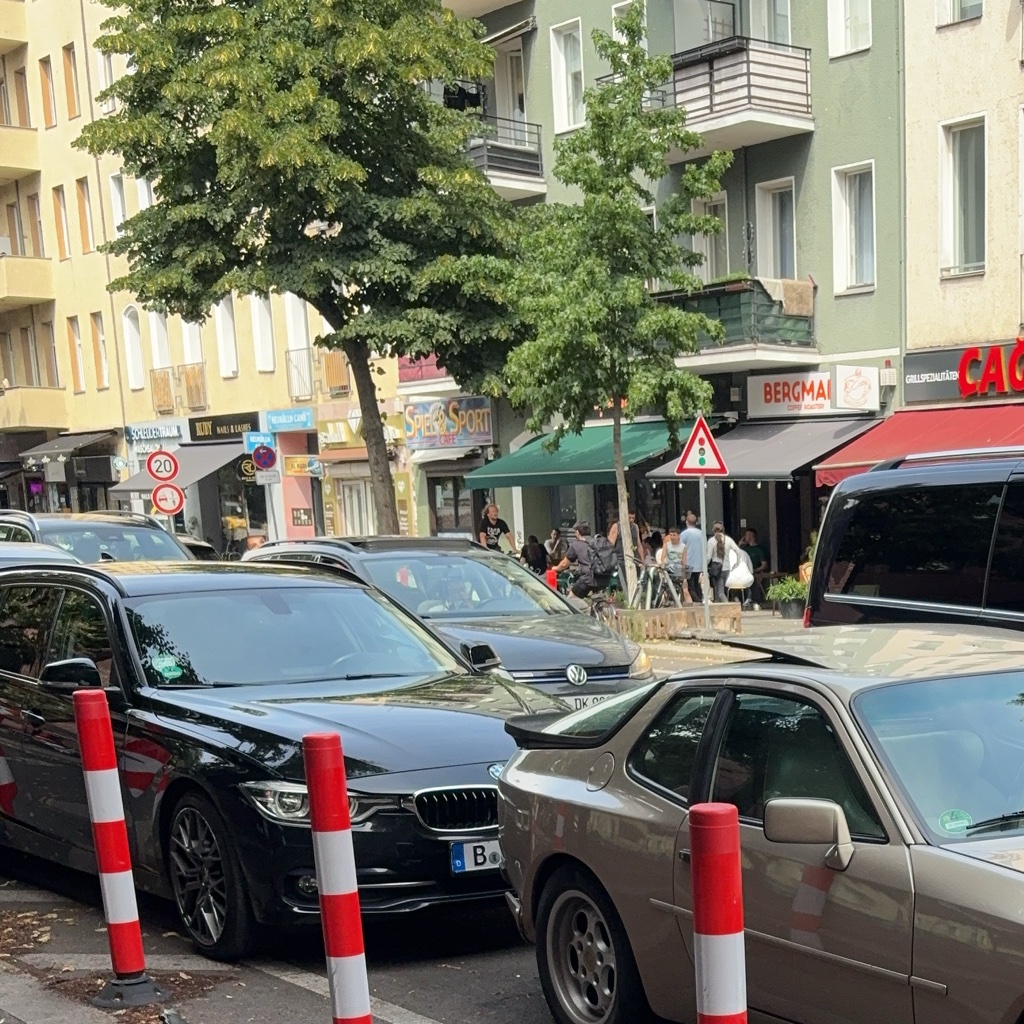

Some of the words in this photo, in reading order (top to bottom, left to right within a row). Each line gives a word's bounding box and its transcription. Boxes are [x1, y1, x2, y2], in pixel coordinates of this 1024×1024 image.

[905, 370, 960, 384] GRILLSPEZIALITÄTEN
[154, 459, 172, 473] 20
[473, 845, 487, 867] B
